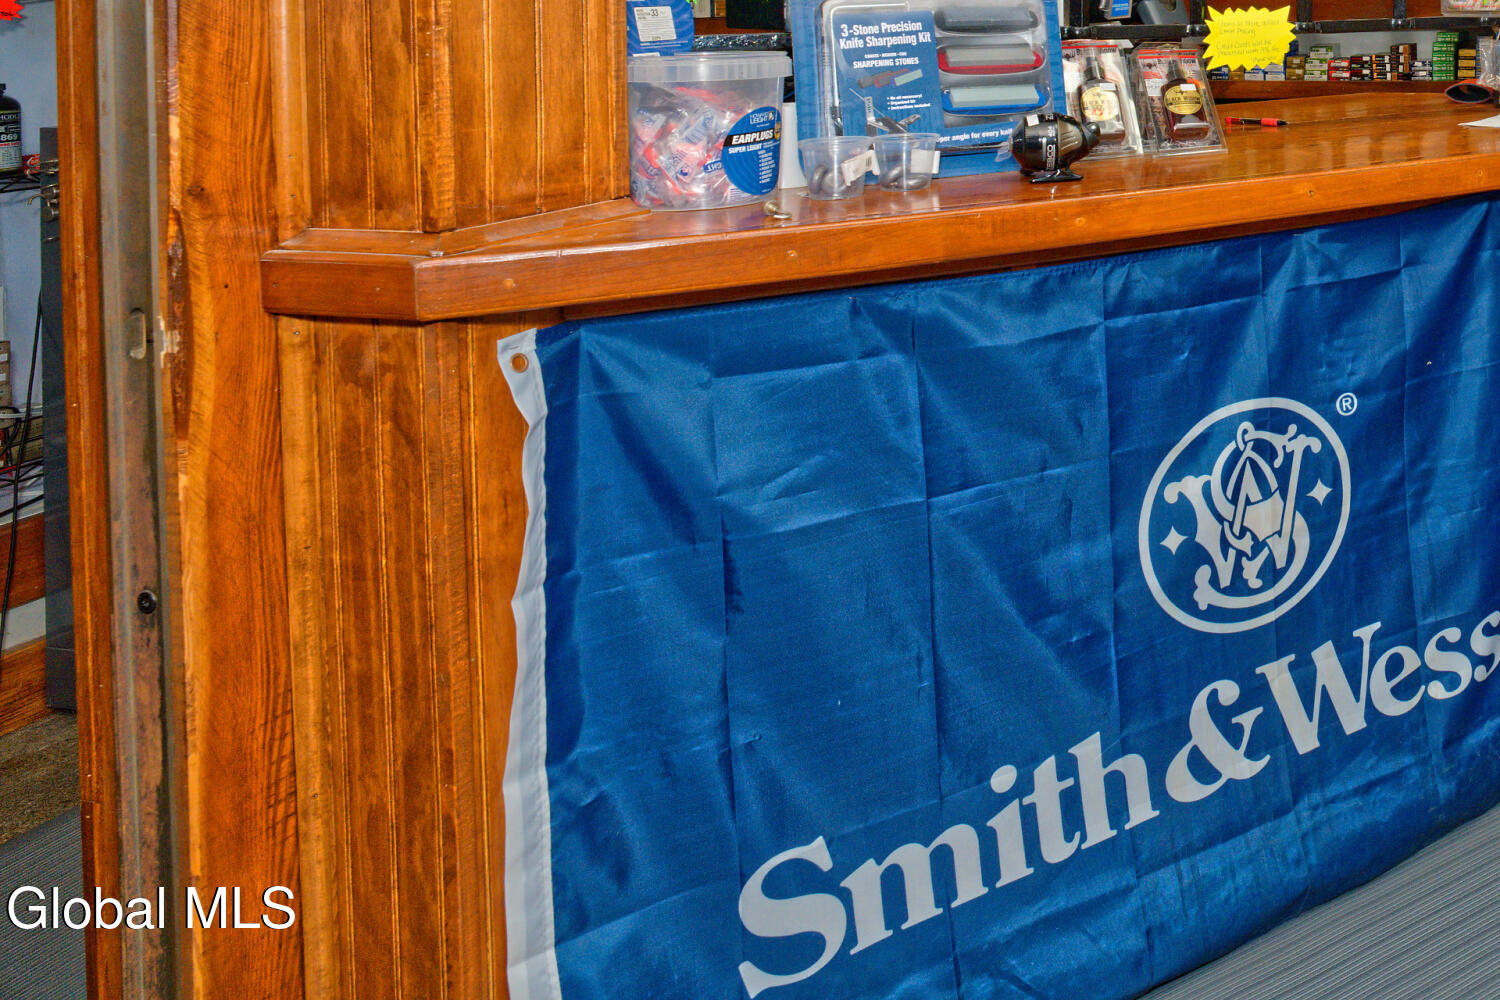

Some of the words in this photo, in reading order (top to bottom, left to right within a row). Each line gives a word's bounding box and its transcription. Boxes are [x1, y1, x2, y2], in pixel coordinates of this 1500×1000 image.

[840, 23, 880, 37] 3-Stone
[881, 20, 922, 33] Precision
[840, 37, 864, 49] Knife
[866, 33, 918, 48] Sharpening
[918, 31, 932, 43] Kit
[732, 129, 774, 146] EARPLUGS
[736, 729, 1161, 999] Smith
[1163, 677, 1271, 804] &
